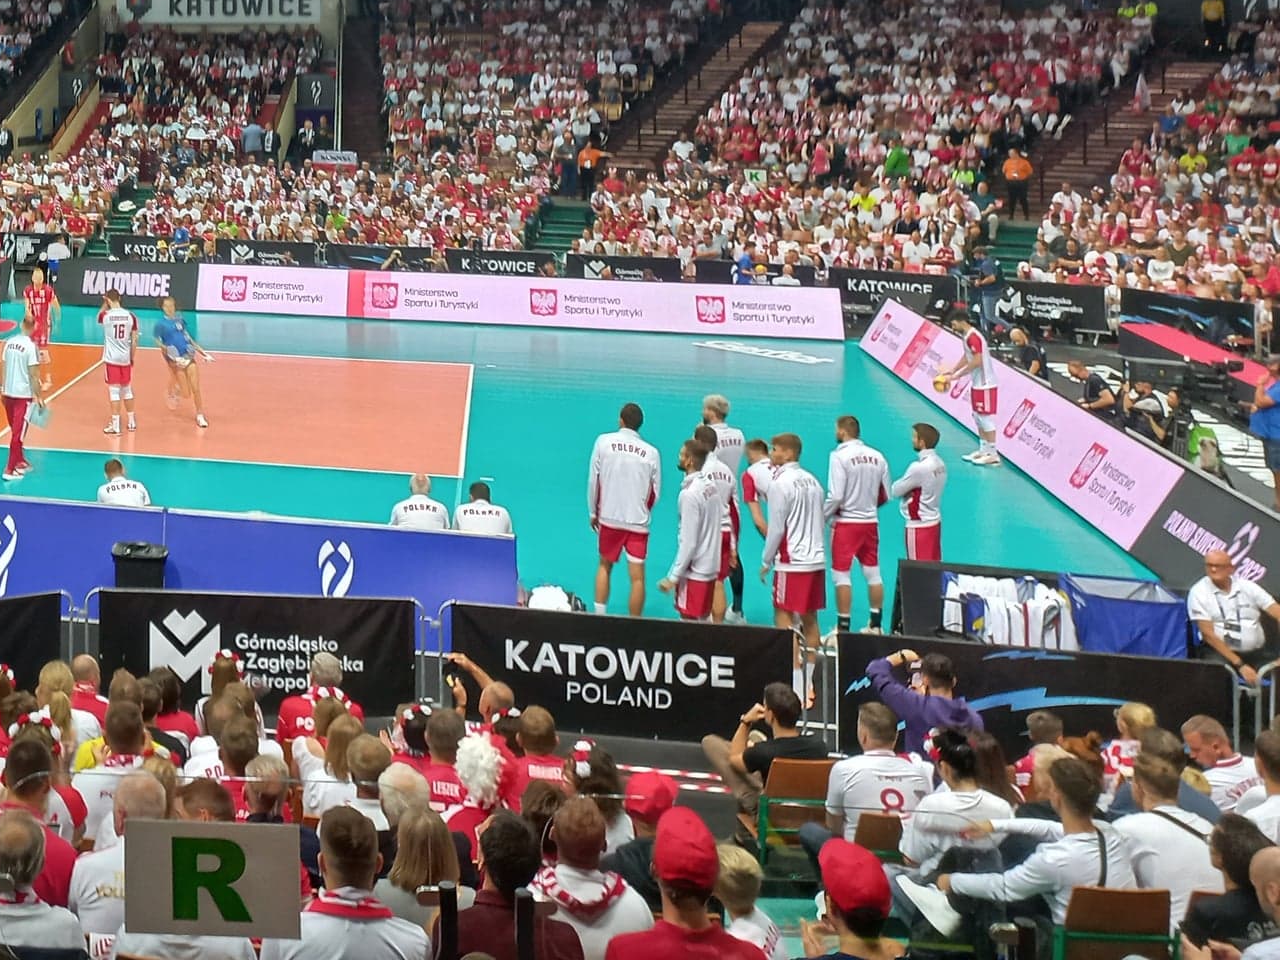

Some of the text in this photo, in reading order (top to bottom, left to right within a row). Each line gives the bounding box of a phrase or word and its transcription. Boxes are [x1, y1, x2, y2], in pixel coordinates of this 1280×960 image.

[82, 270, 170, 297] KATOWICE
[252, 281, 305, 291] Ministerstwo
[252, 291, 280, 303] Sportu
[285, 292, 323, 304] Turystyki
[404, 287, 459, 298] Ministerstwo
[404, 298, 433, 310] Sportu
[440, 299, 479, 311] Turystyki
[564, 294, 621, 306] Ministerstwo
[732, 301, 792, 312] Ministerstwo
[564, 305, 595, 317] Sportu
[601, 307, 643, 320] Turystyki
[732, 312, 765, 325] Sportu
[773, 314, 815, 326] Turystyki
[113, 324, 125, 340] 16
[611, 442, 647, 458] POLSKA
[106, 483, 138, 493] POLSKA
[403, 503, 438, 513] POLSKA
[463, 508, 501, 517] POLSKA
[234, 632, 339, 654] Górnośląsko
[504, 637, 737, 688] KATOWICE
[565, 681, 673, 710] POLAND
[432, 780, 461, 798] LESZEK
[171, 836, 253, 923] R
